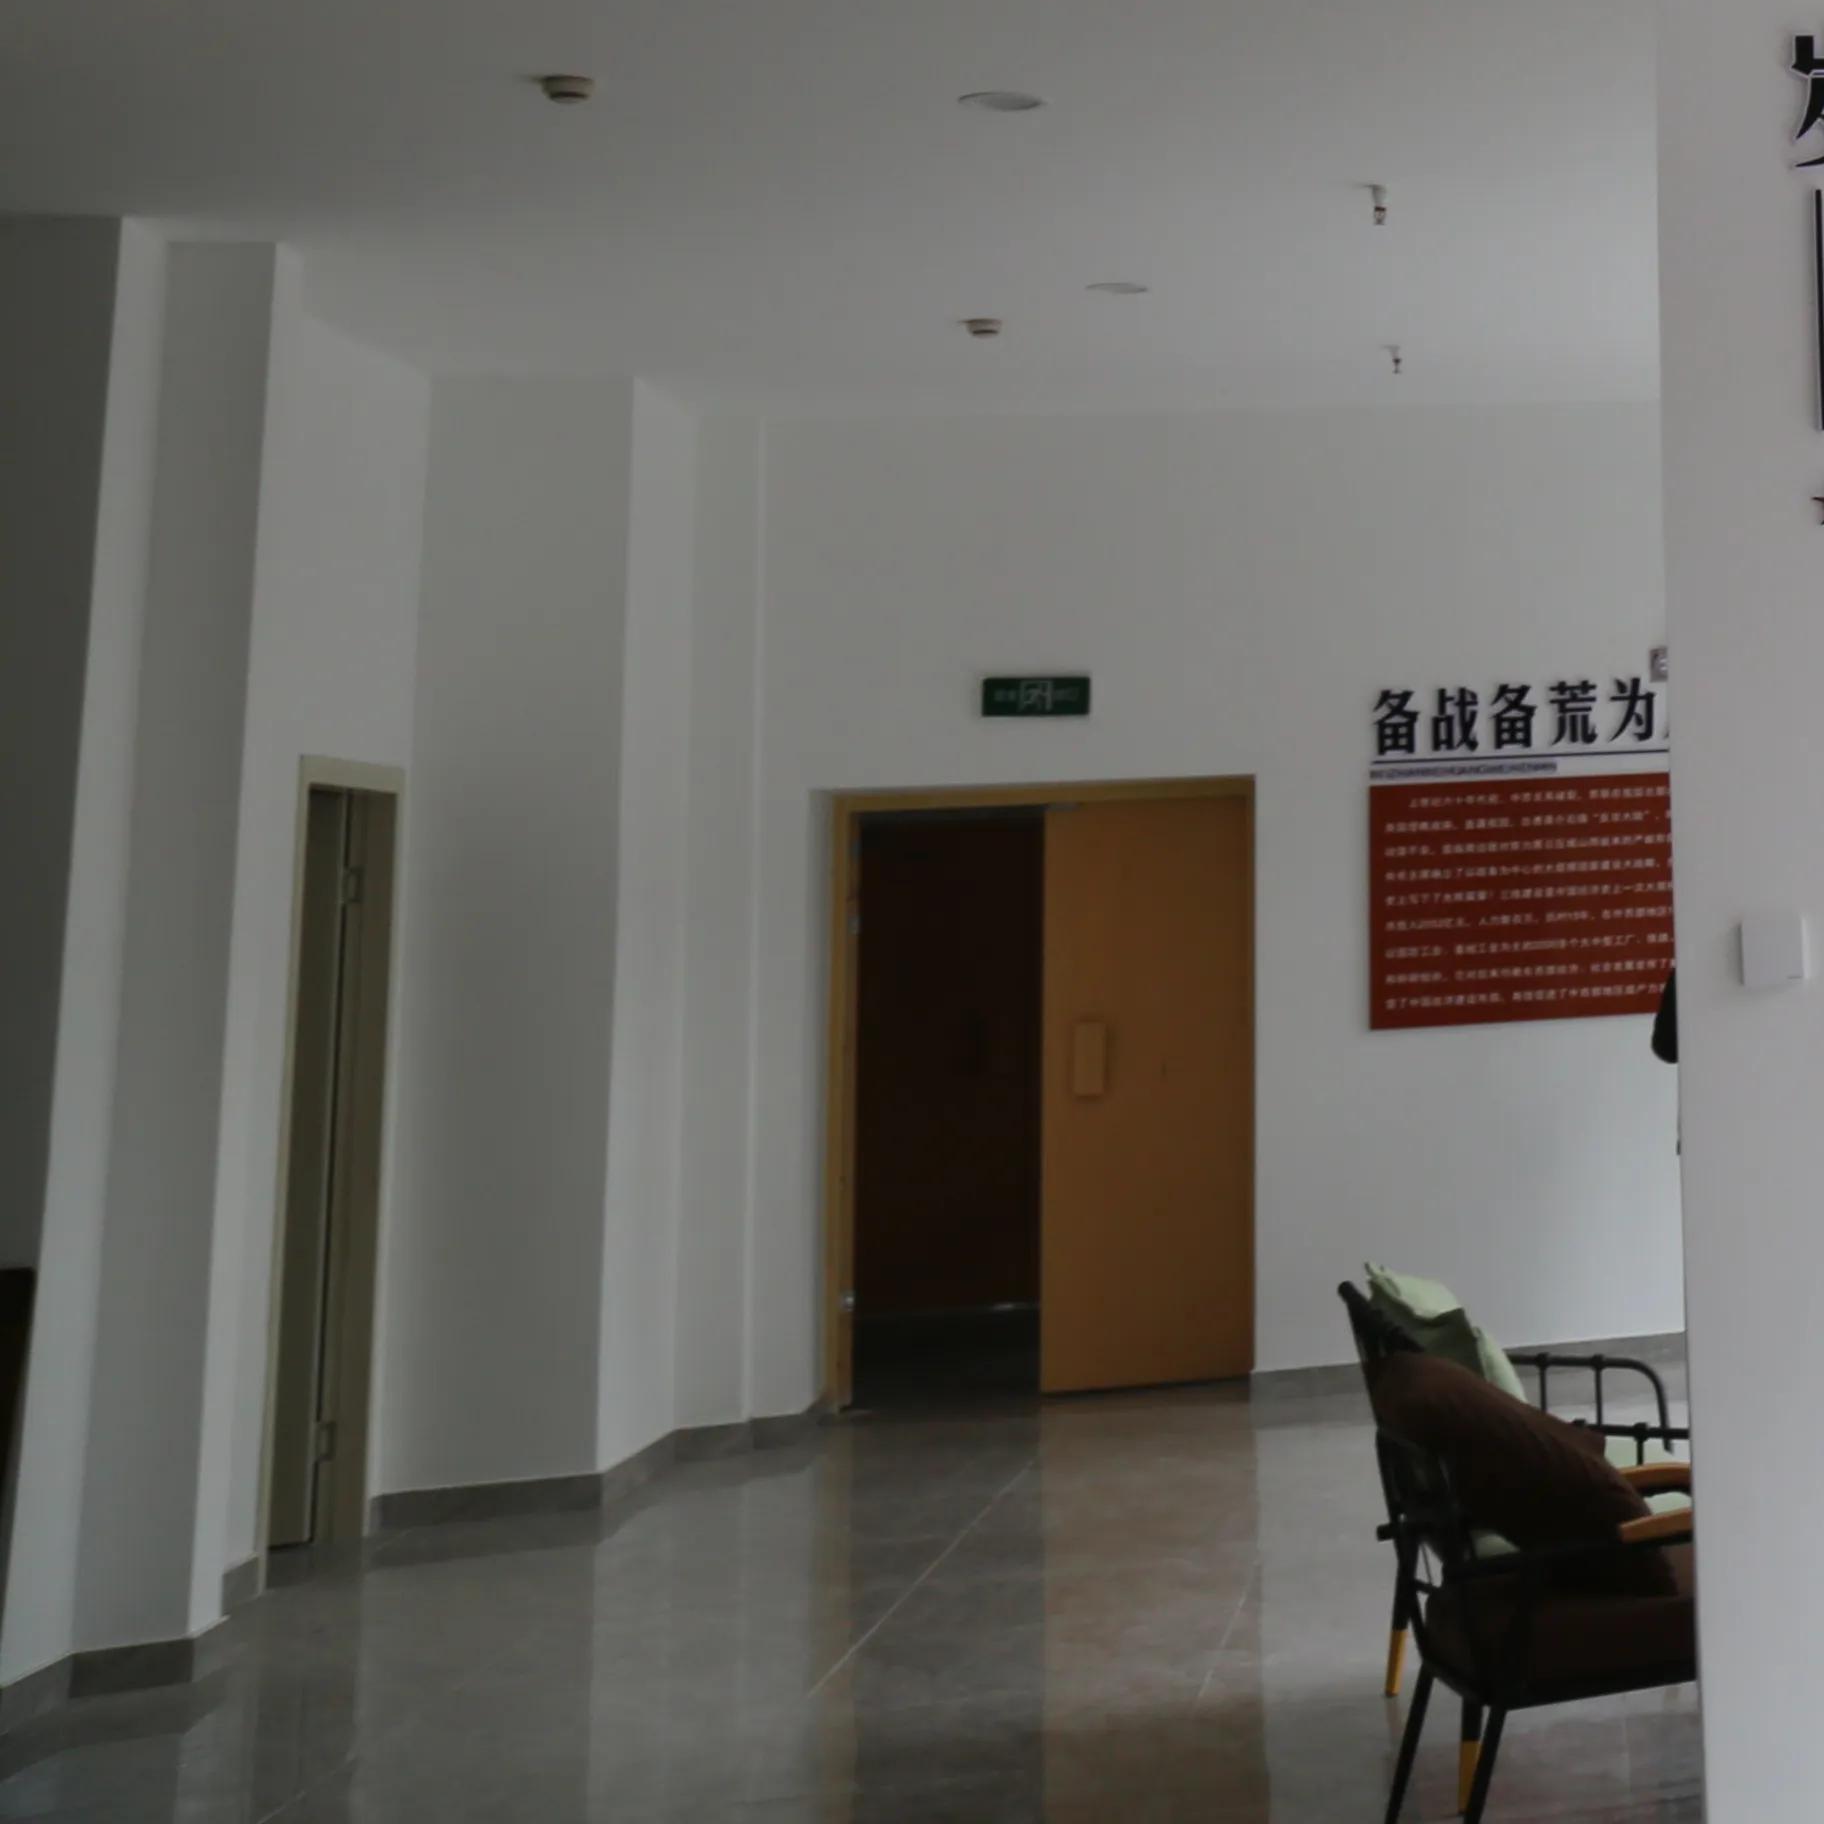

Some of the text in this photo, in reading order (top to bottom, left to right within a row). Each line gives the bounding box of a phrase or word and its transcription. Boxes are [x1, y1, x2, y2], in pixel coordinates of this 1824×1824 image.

[1372, 677, 1670, 756] 备战备荒为
